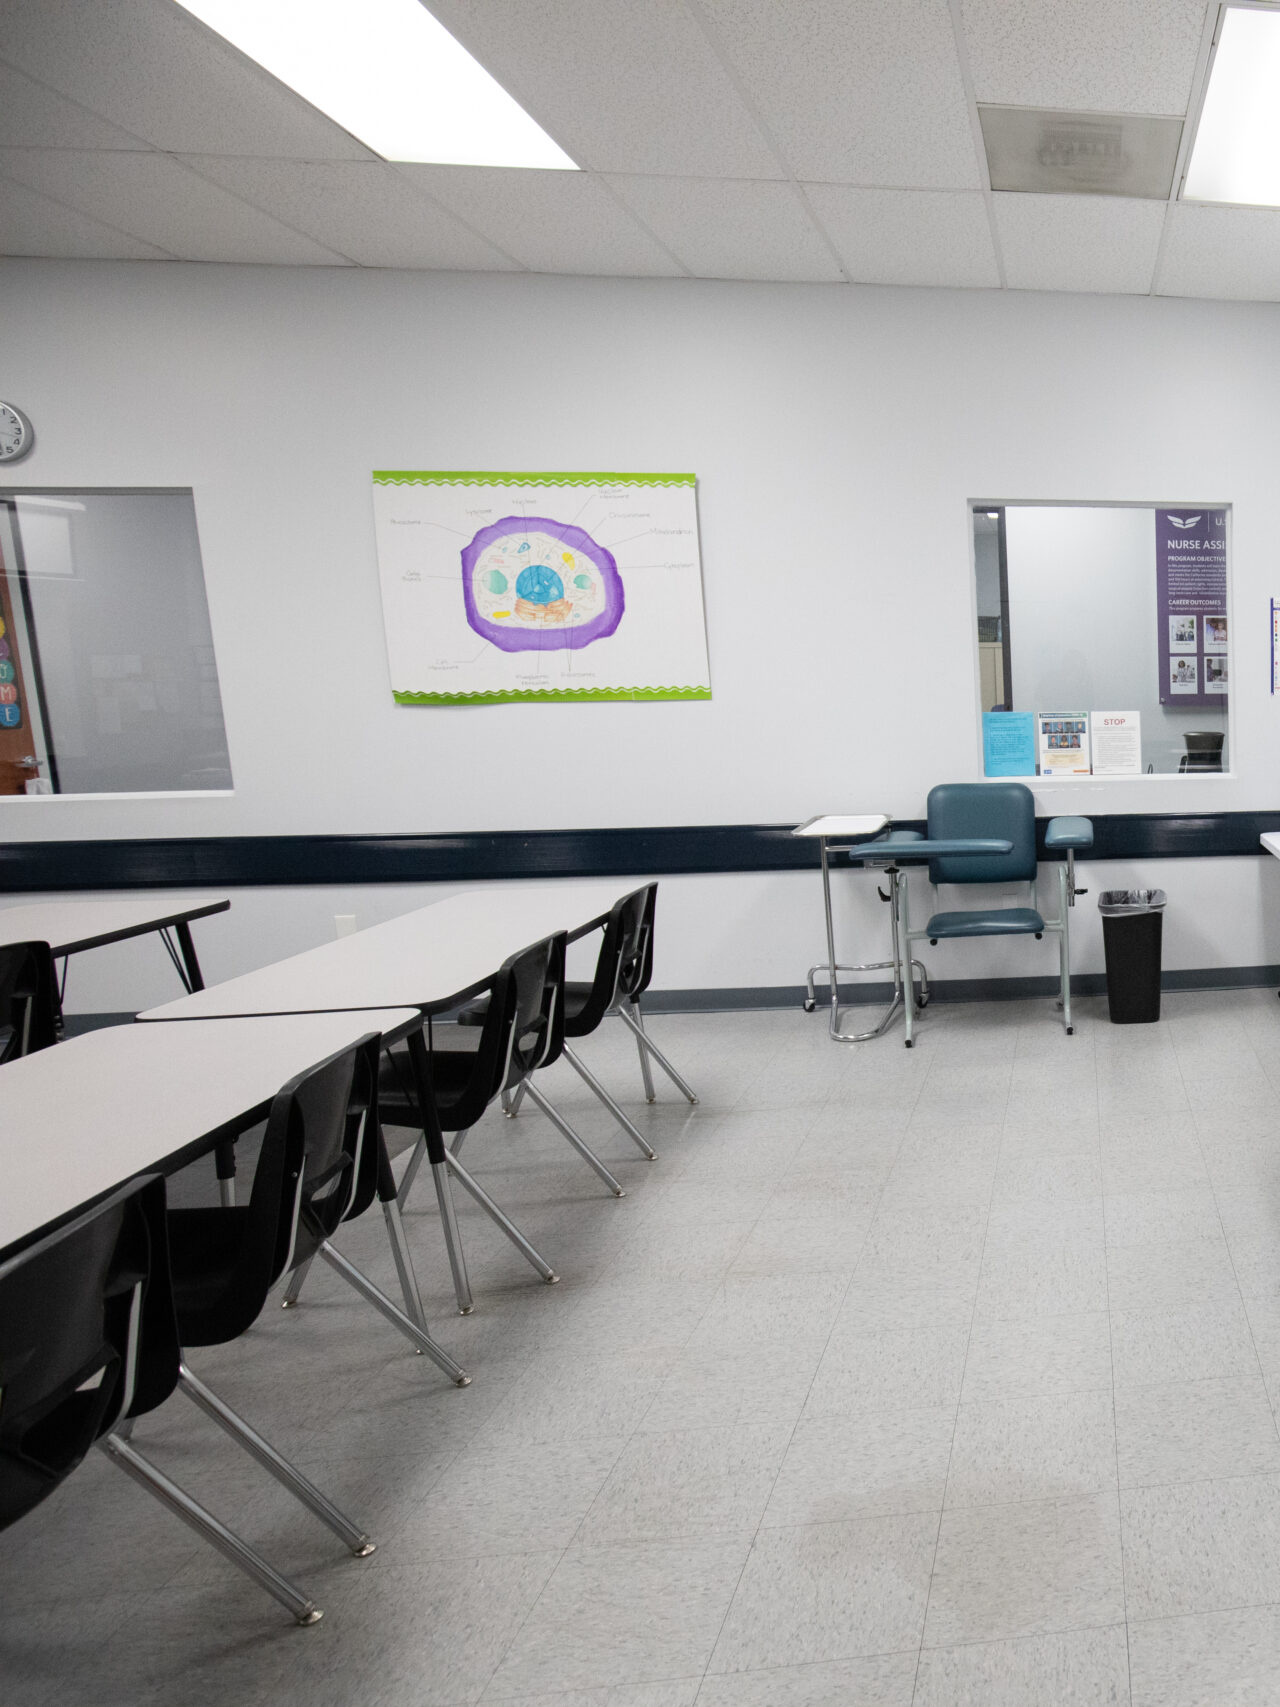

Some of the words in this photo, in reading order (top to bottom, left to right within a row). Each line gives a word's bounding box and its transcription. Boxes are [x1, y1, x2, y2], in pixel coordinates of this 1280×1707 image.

[1167, 539, 1201, 549] NURSE
[1202, 540, 1225, 550] ASSI
[1103, 718, 1126, 726] STOP
